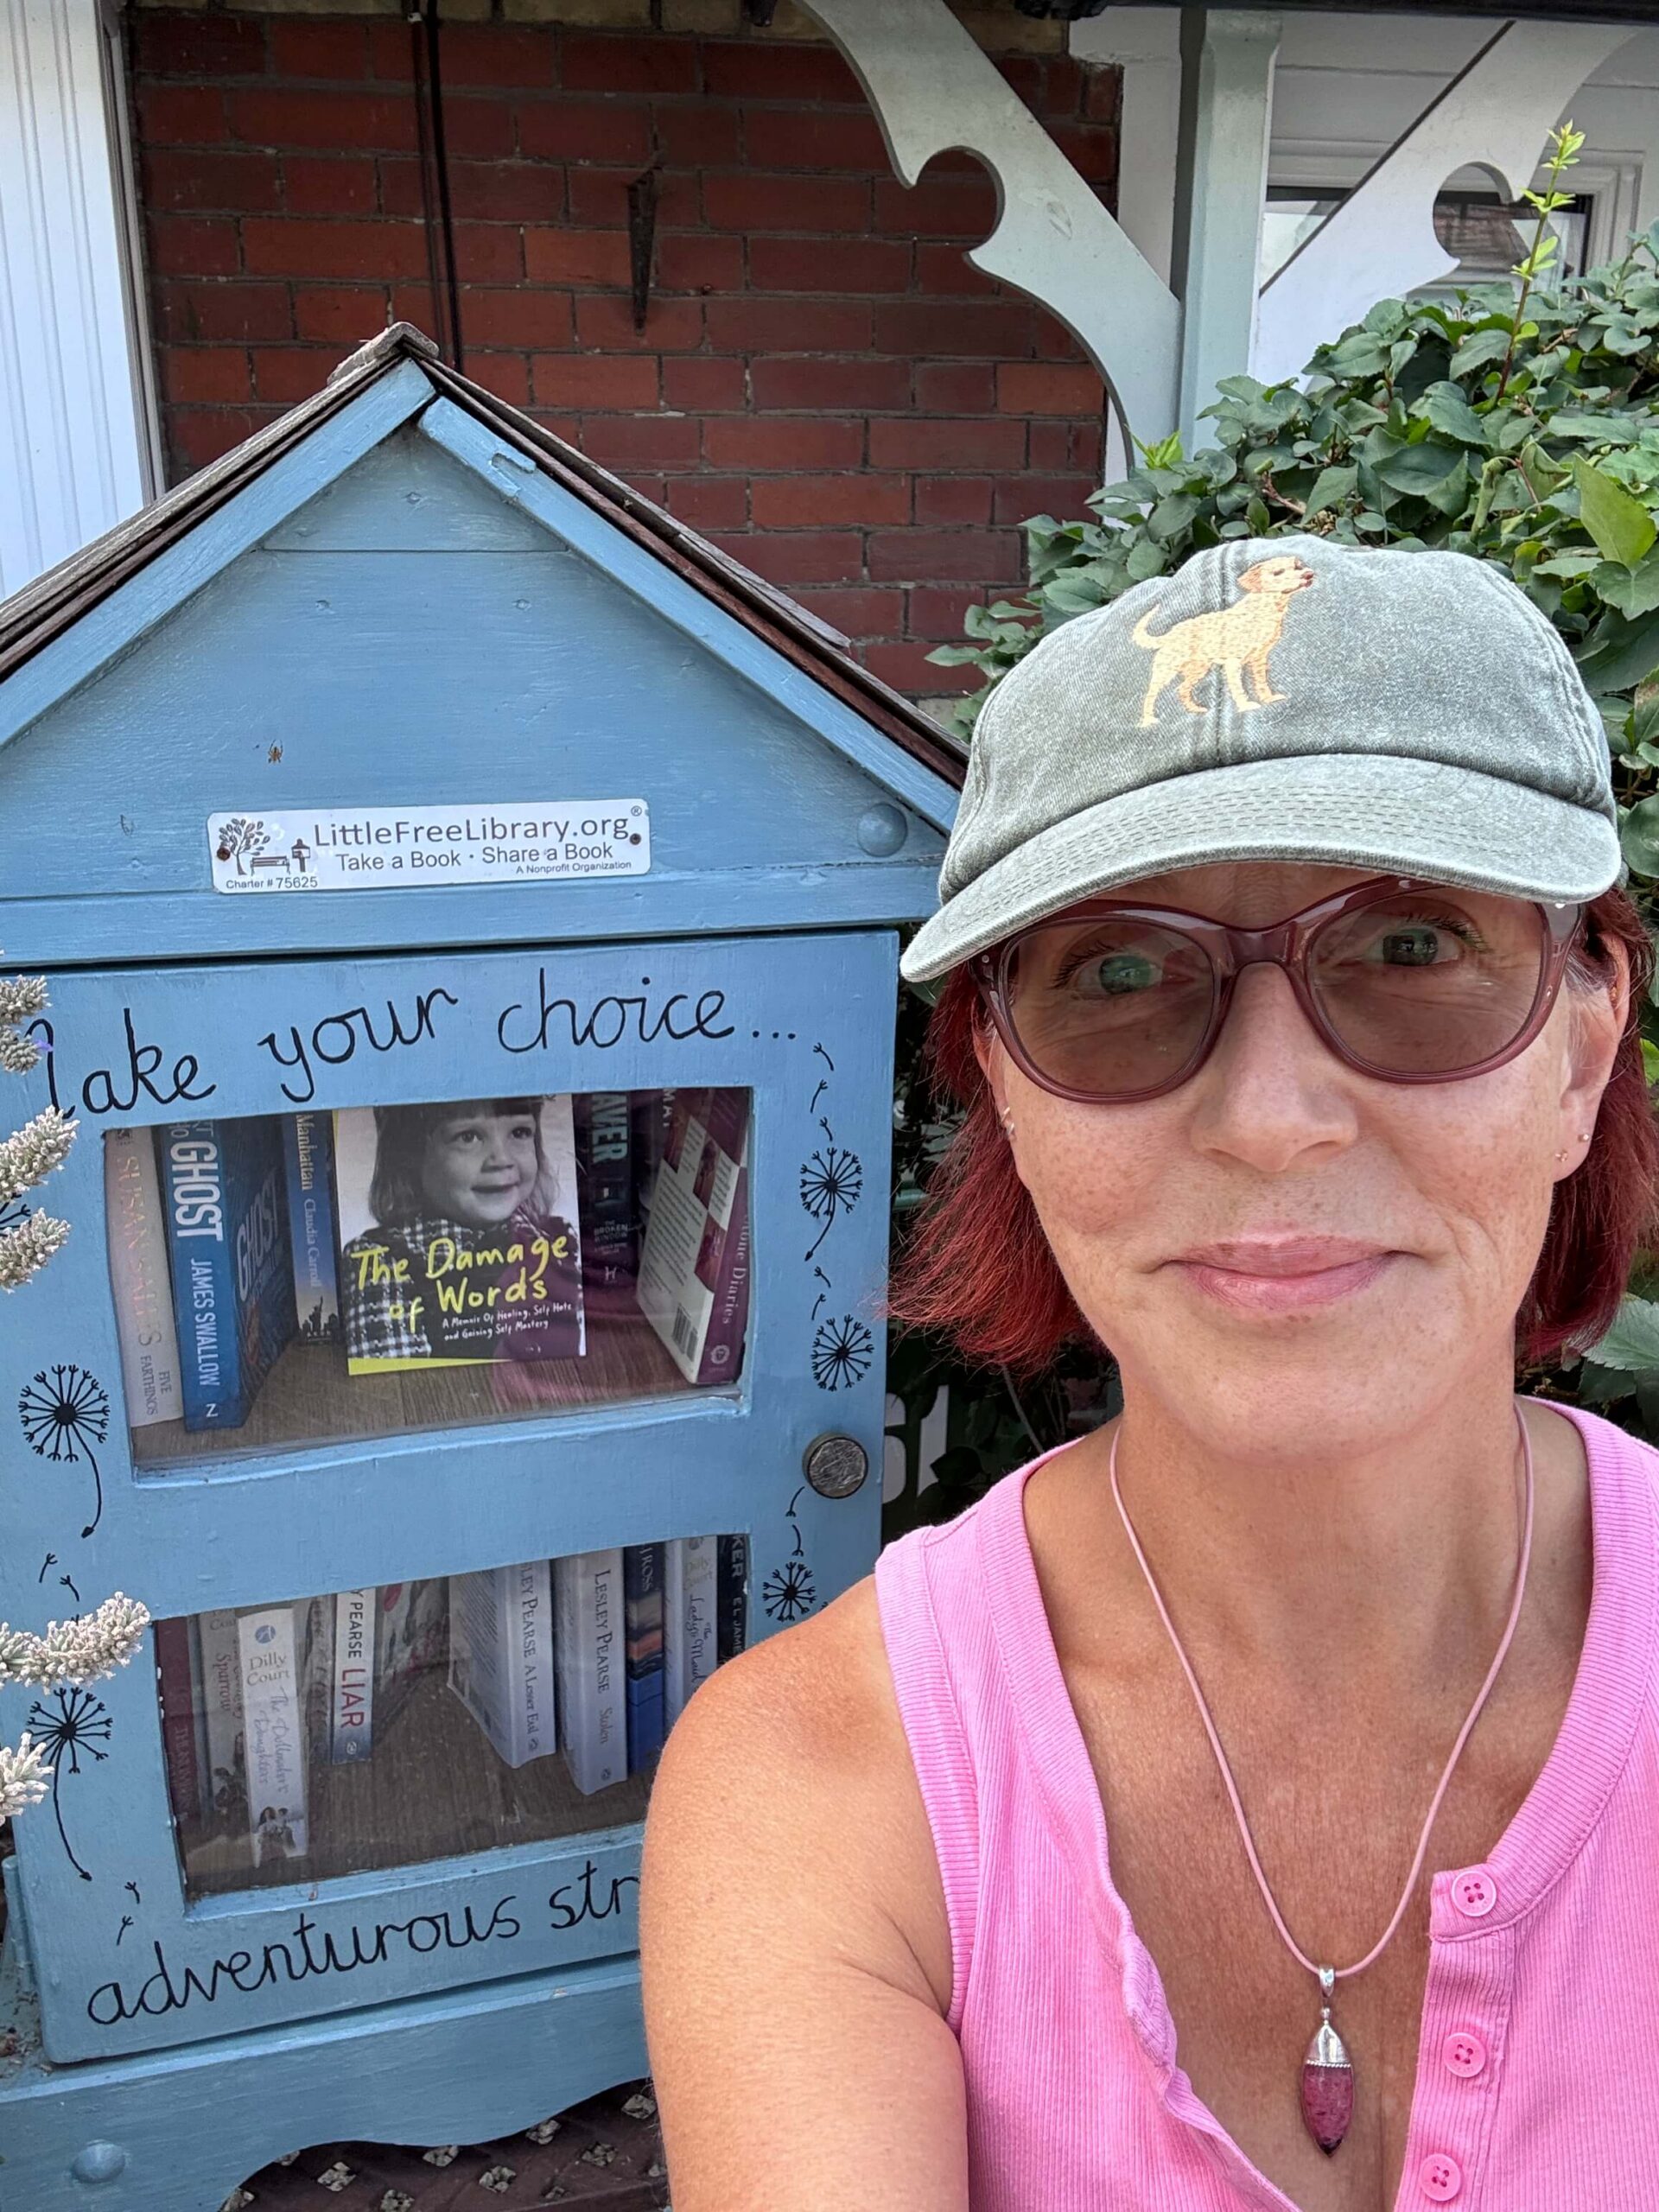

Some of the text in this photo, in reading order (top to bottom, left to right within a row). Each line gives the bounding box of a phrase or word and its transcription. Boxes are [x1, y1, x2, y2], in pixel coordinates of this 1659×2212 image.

[314, 815, 630, 849] LittleFreeLibrary.org
[335, 842, 613, 872] Take a Book Share a Book
[226, 876, 319, 890] Charter # 75625
[516, 861, 632, 874] A Nonprofit Organization
[258, 988, 458, 1103] your
[170, 1141, 224, 1242] GHOST
[236, 1172, 279, 1303] GHOST
[303, 1198, 322, 1288] Claudia Carroll
[350, 1235, 570, 1291] The Damage
[190, 1257, 221, 1387] JAMES SWALLOW
[388, 1266, 549, 1334] of Words
[442, 1318, 449, 1329] A
[451, 1315, 480, 1328] Memoir
[533, 1304, 551, 1316] Self
[552, 1301, 572, 1313] Hate
[721, 1266, 748, 1325] Diaries
[444, 1319, 549, 1341] and Gaining Self Mastery
[140, 1354, 159, 1416] FARTHINGS
[158, 1370, 173, 1396] FIVE
[347, 1601, 365, 1660] PEARSE
[522, 1596, 539, 1659] PEARSE
[594, 1568, 613, 1694] LESLEY PEARSE
[212, 1652, 232, 1712] Sparrow
[246, 1669, 291, 1687] Court
[249, 1652, 288, 1671] Dilly
[524, 1663, 537, 1675] A
[270, 1686, 289, 1713] The
[340, 1668, 366, 1729] LIAR
[250, 1708, 273, 1786] Daughters
[87, 1896, 521, 2026] adventurous
